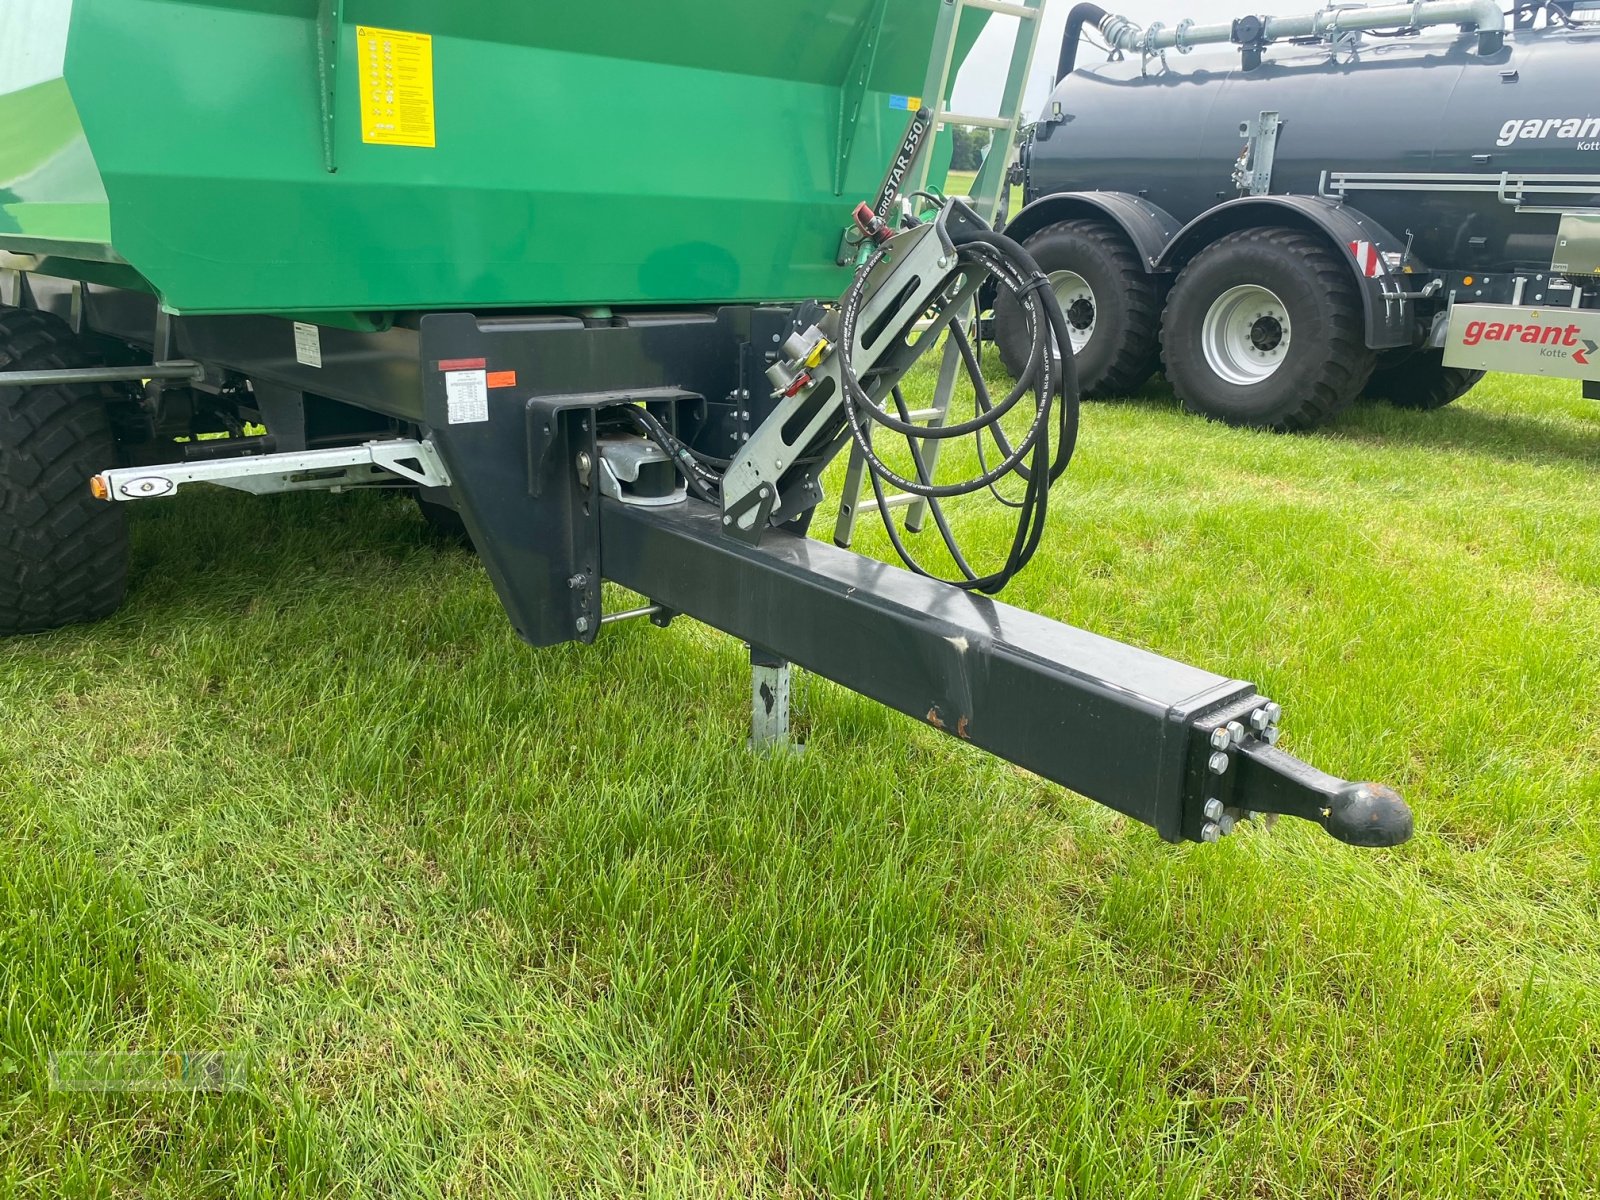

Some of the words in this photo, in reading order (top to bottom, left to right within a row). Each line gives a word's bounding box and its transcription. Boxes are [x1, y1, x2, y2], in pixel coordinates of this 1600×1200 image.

[904, 121, 923, 155] 550
[1577, 140, 1600, 151] Kott
[1462, 320, 1581, 346] garant
[1540, 347, 1568, 358] Kotte
